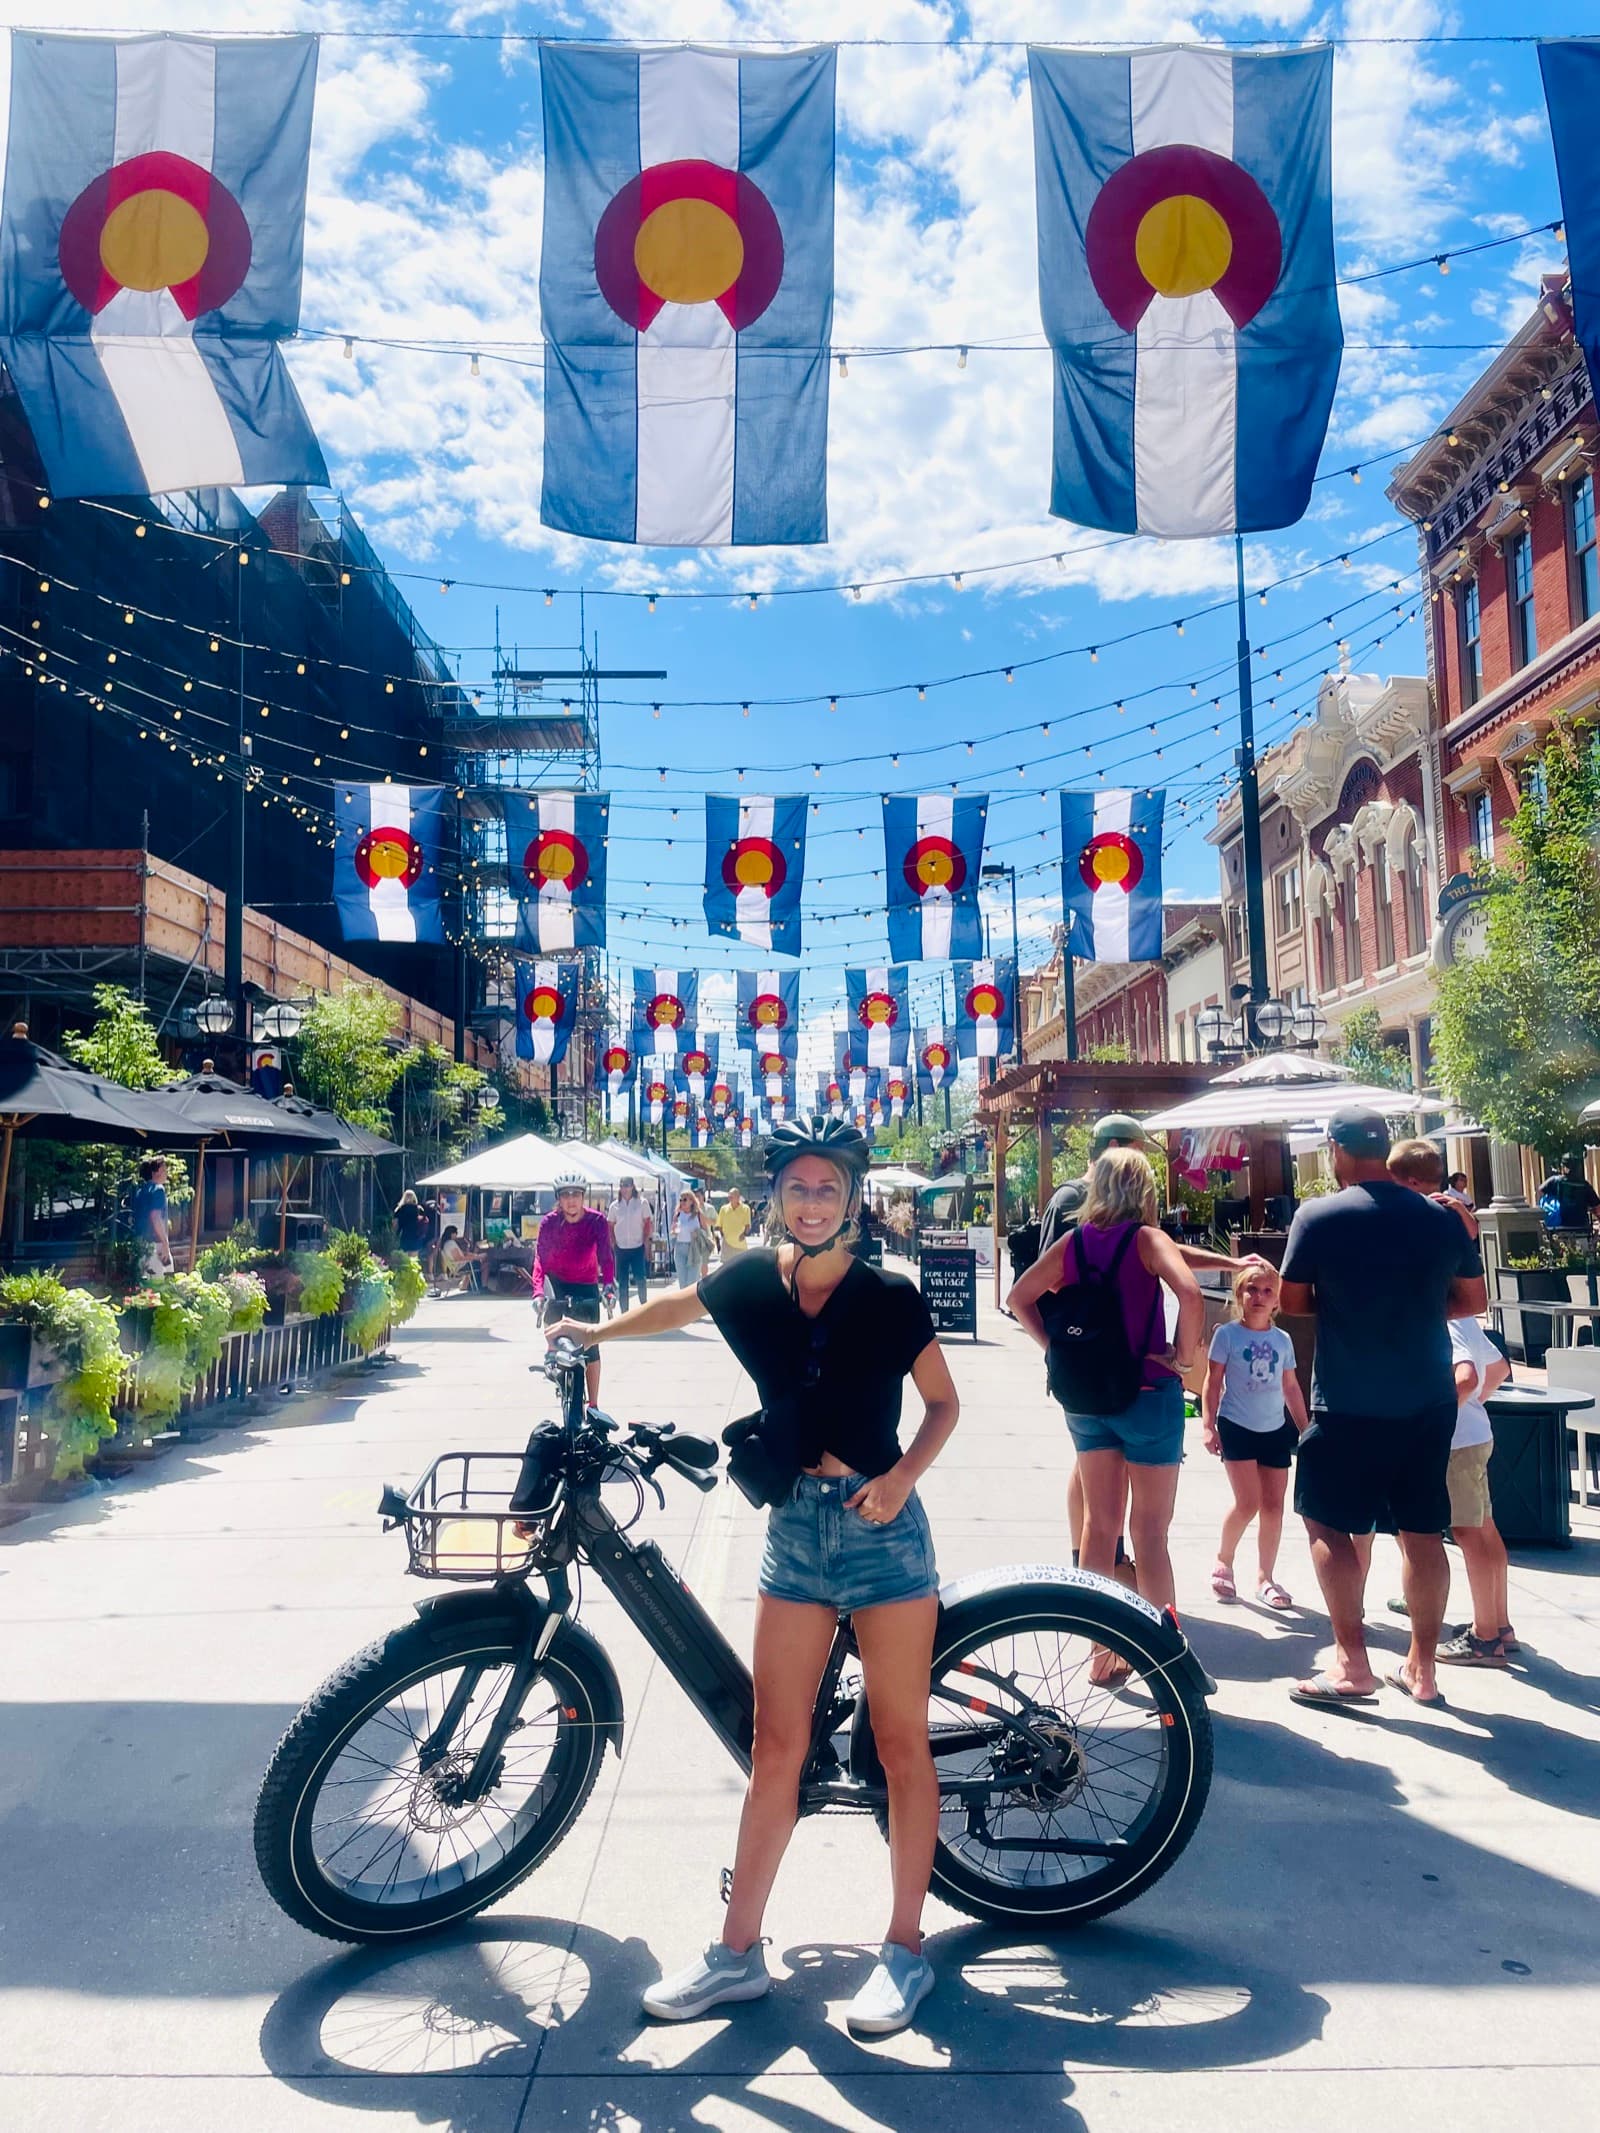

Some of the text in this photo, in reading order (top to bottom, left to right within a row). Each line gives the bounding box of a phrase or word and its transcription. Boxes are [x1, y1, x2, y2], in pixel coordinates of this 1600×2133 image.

[1447, 884, 1469, 900] THE
[1461, 927, 1472, 937] 10
[930, 1278, 966, 1286] VINTAGE
[932, 1299, 964, 1307] MARGS
[625, 1572, 688, 1653] RAD POWER BIKES
